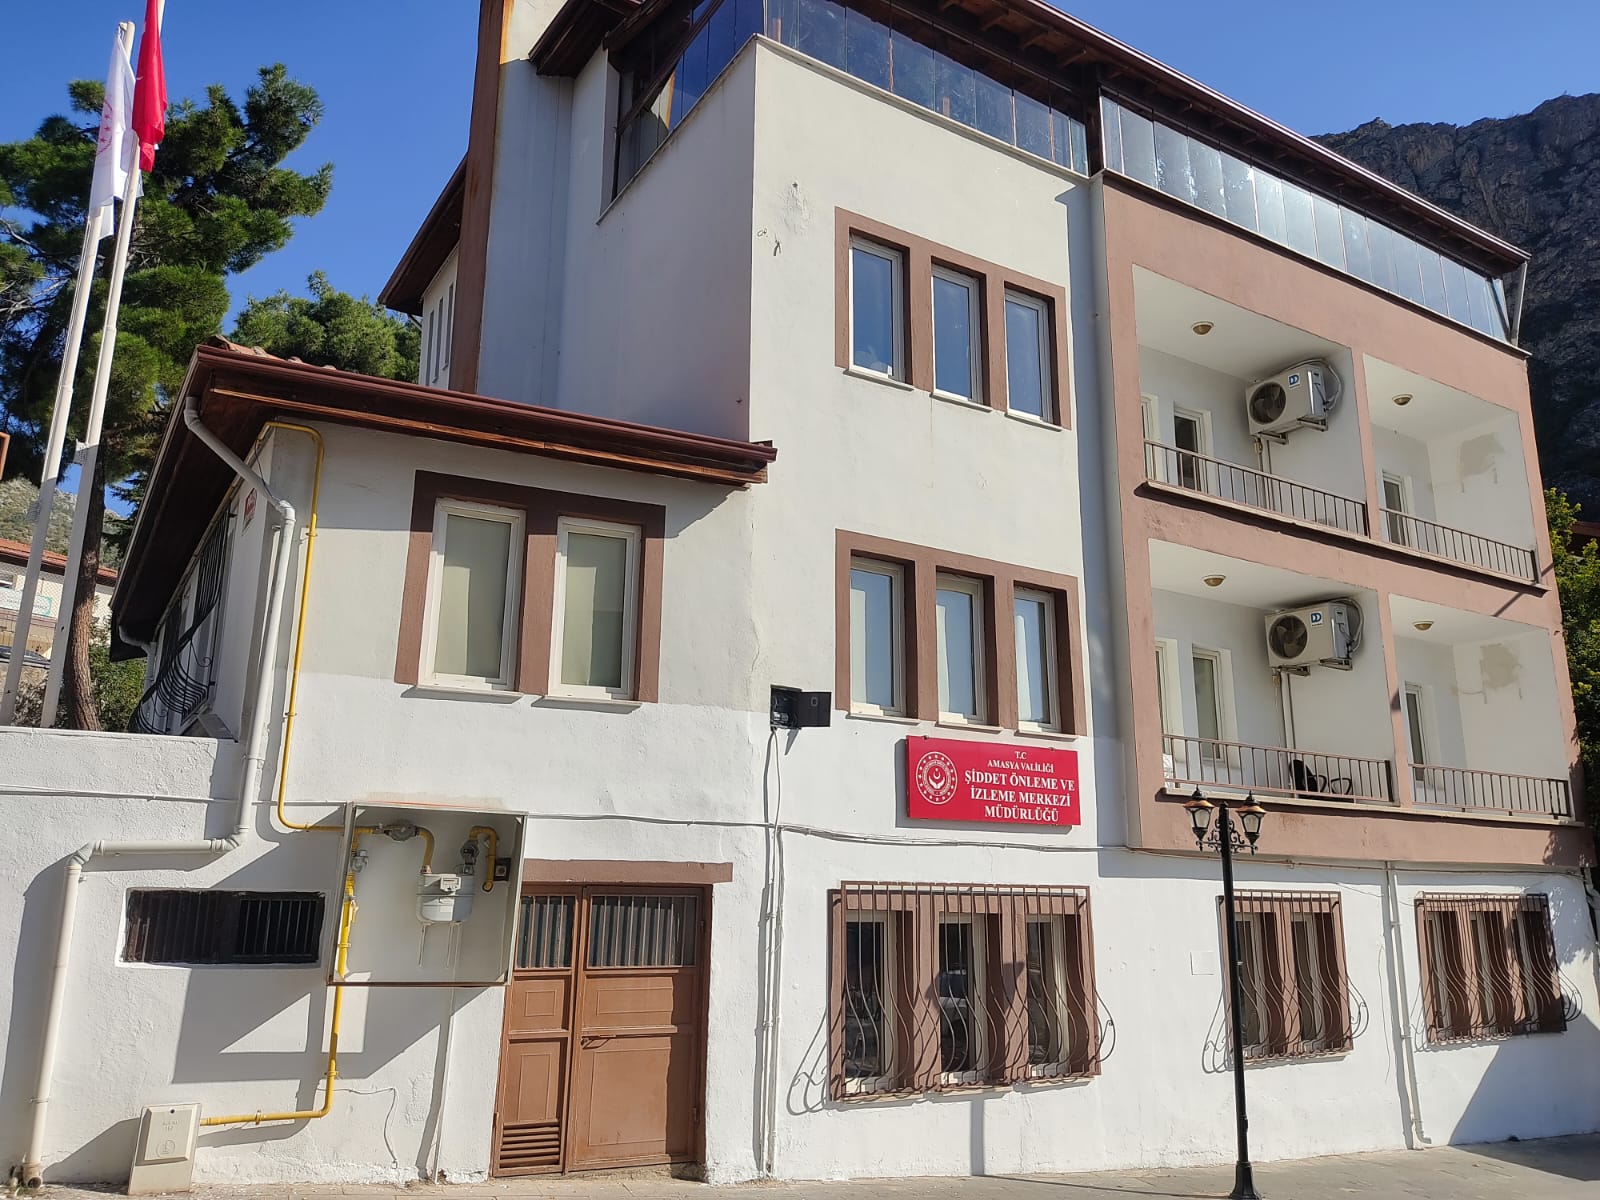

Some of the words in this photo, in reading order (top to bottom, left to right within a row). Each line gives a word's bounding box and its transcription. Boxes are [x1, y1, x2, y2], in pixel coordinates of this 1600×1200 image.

[988, 759, 1019, 770] AMASYA
[1020, 762, 1054, 773] VALİLİĞİ
[964, 769, 1007, 786] ŞİDDET
[1009, 772, 1058, 790] ÖNLEME
[1060, 779, 1075, 791] VE
[971, 786, 1016, 802] İZLEME
[1019, 792, 1071, 807] MERKEZİ
[985, 804, 1059, 822] MÜDÜRLÜĞÜ
